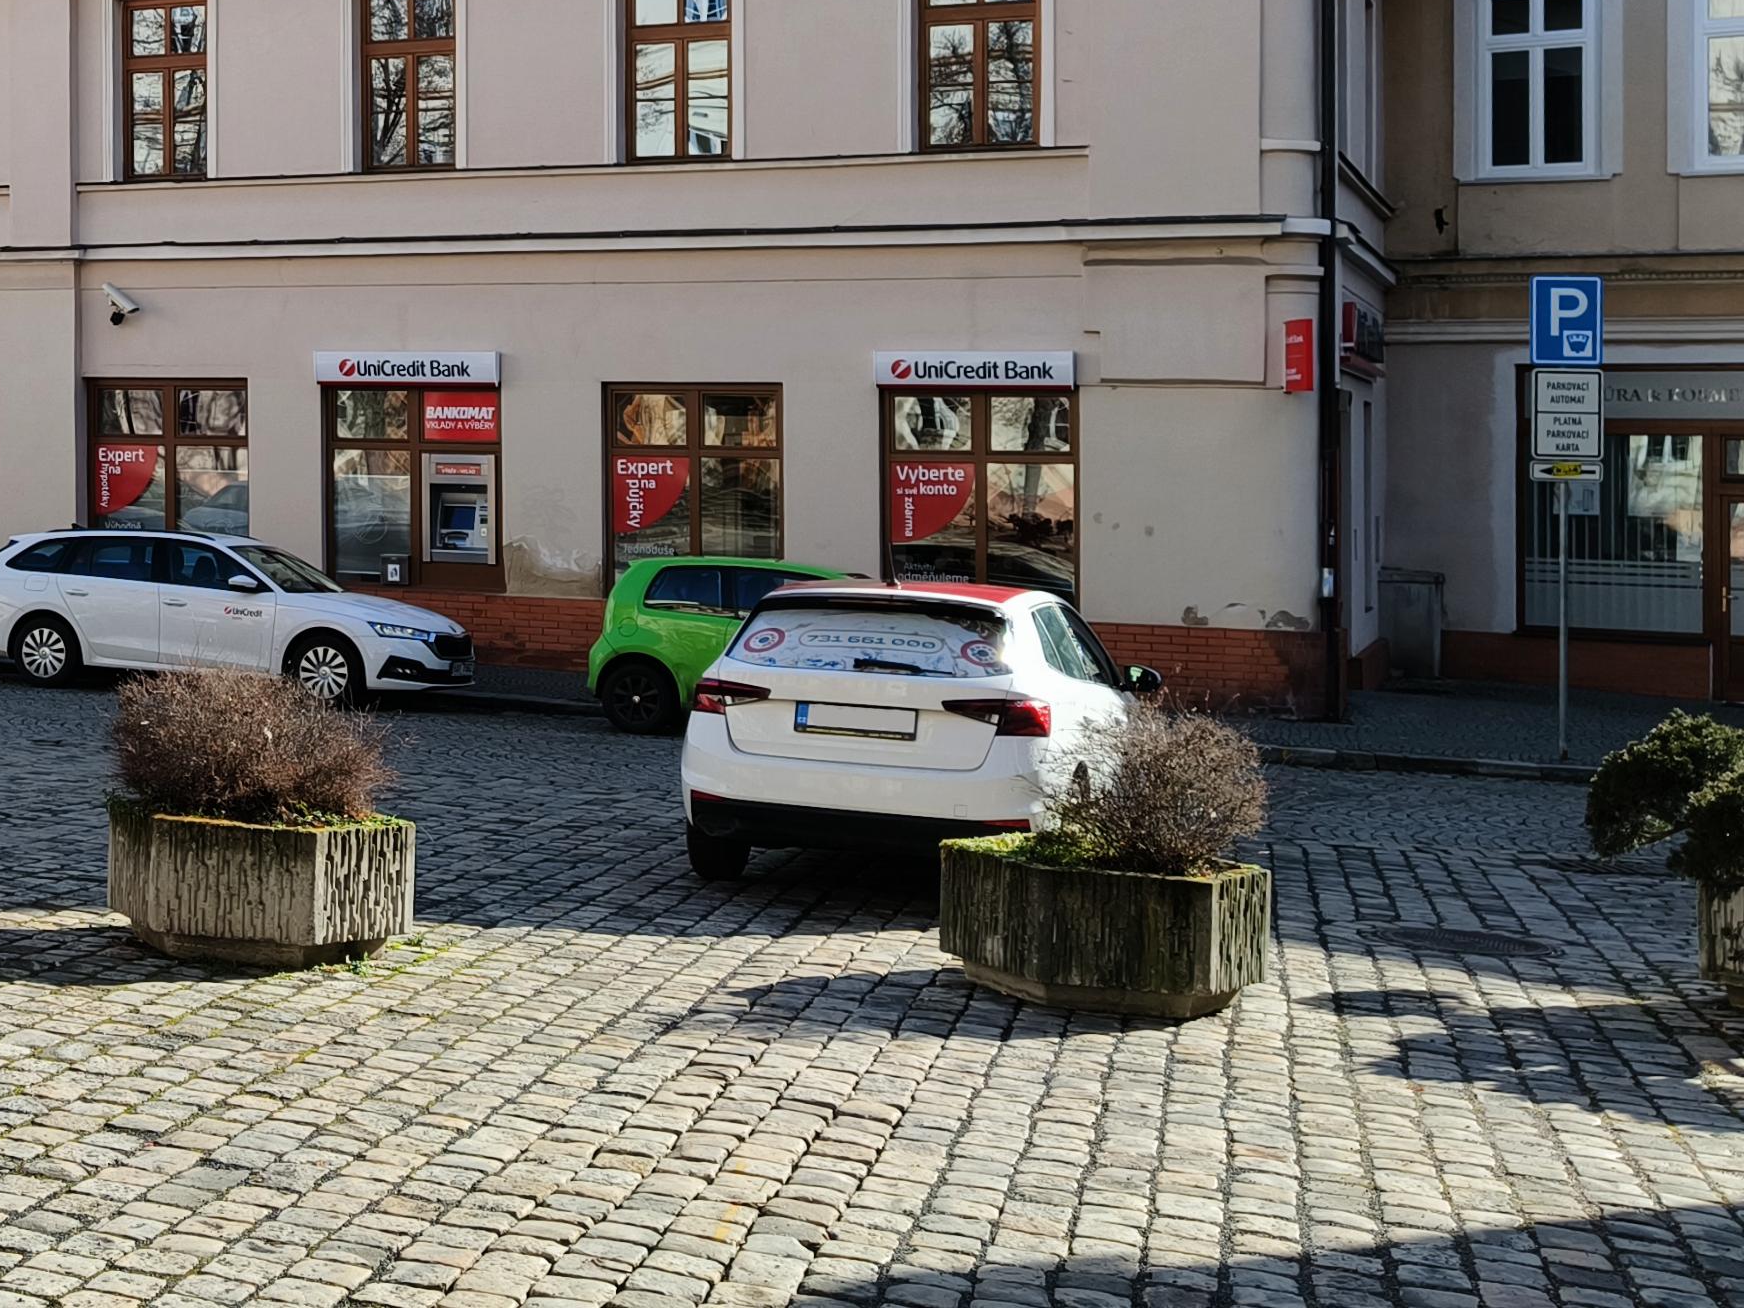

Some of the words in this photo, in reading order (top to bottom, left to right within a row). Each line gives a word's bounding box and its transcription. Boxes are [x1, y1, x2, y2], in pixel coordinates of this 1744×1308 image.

[1550, 287, 1589, 337] P
[356, 359, 427, 377] UniCredit
[429, 359, 471, 378] Bank
[914, 360, 999, 379] UniCredit
[1004, 360, 1054, 380] Bank
[1546, 381, 1590, 391] PARKOVACÍ
[1549, 395, 1586, 405] AUTOMAT
[425, 406, 495, 420] BANKOMAT
[425, 420, 456, 429] VKLADY
[456, 421, 463, 429] A
[464, 419, 495, 430] VÝBĚRY
[1553, 416, 1583, 426] PLATNÁ
[1546, 429, 1590, 439] PARKOVACÍ
[1555, 443, 1580, 452] KARTA
[98, 447, 145, 465] Expert
[108, 465, 121, 475] na
[617, 458, 674, 478] Expert
[896, 465, 965, 484] Vyberte
[99, 463, 111, 508] hypotéky
[640, 479, 656, 489] na
[919, 482, 957, 495] konto
[626, 479, 644, 528] půjčky
[904, 496, 915, 537] zdarma
[623, 544, 675, 555] Jednoduše
[232, 607, 263, 618] UniCredit
[807, 634, 843, 643] 731
[847, 635, 887, 645] 661
[891, 638, 937, 649] 000
